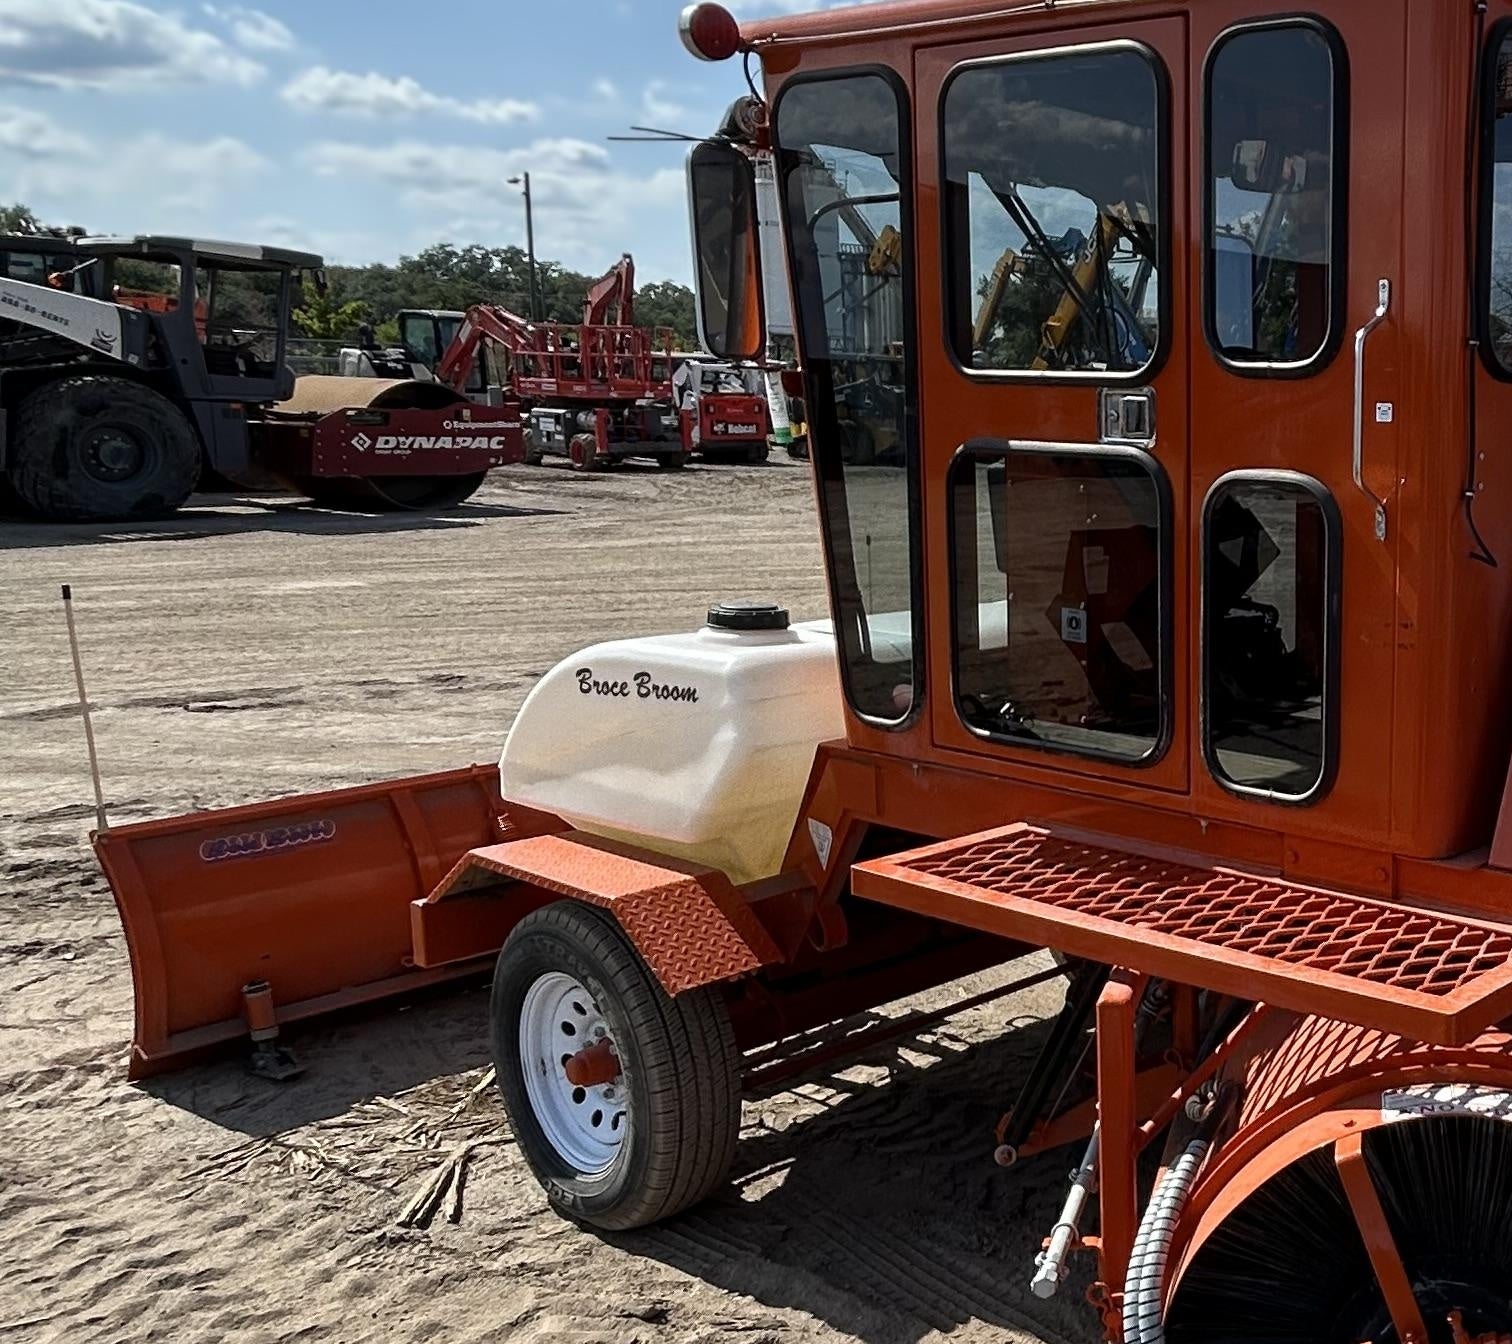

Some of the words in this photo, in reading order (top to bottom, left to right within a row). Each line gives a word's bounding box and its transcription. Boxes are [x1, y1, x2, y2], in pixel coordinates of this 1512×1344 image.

[728, 423, 757, 434] Bobcat
[375, 436, 506, 450] DYNAPAC
[575, 667, 630, 697] Broce
[632, 671, 699, 703] Broom
